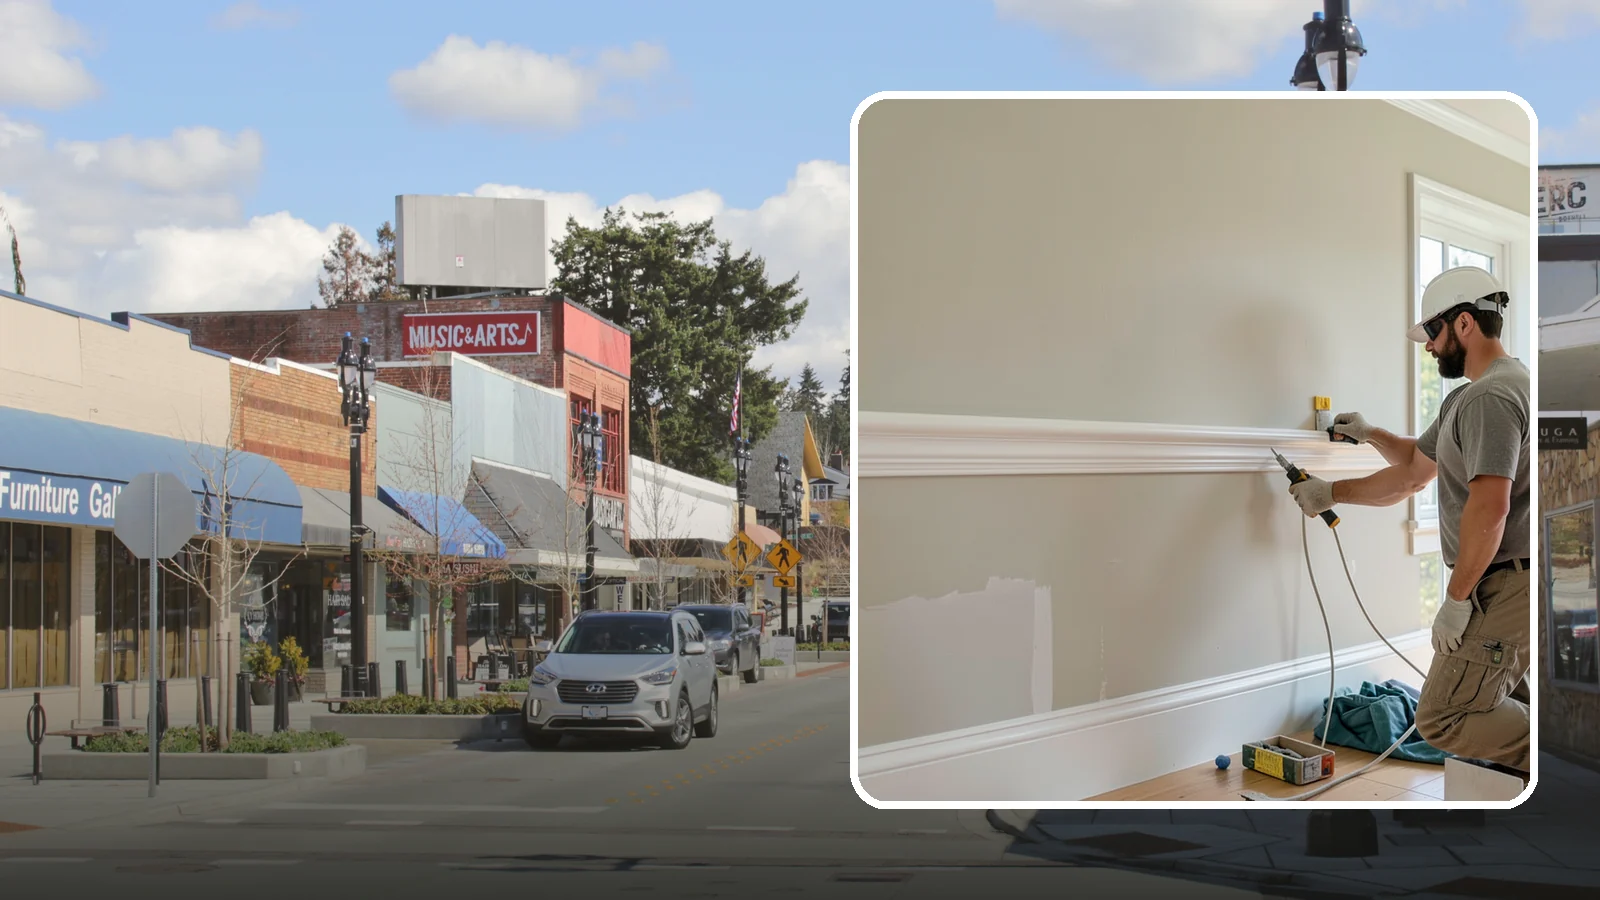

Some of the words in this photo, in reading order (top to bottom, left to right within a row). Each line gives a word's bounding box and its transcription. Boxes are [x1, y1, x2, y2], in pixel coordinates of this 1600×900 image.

[1540, 427, 1577, 437] UGA
[0, 471, 79, 516] Furniture
[453, 563, 478, 574] SUSHI
